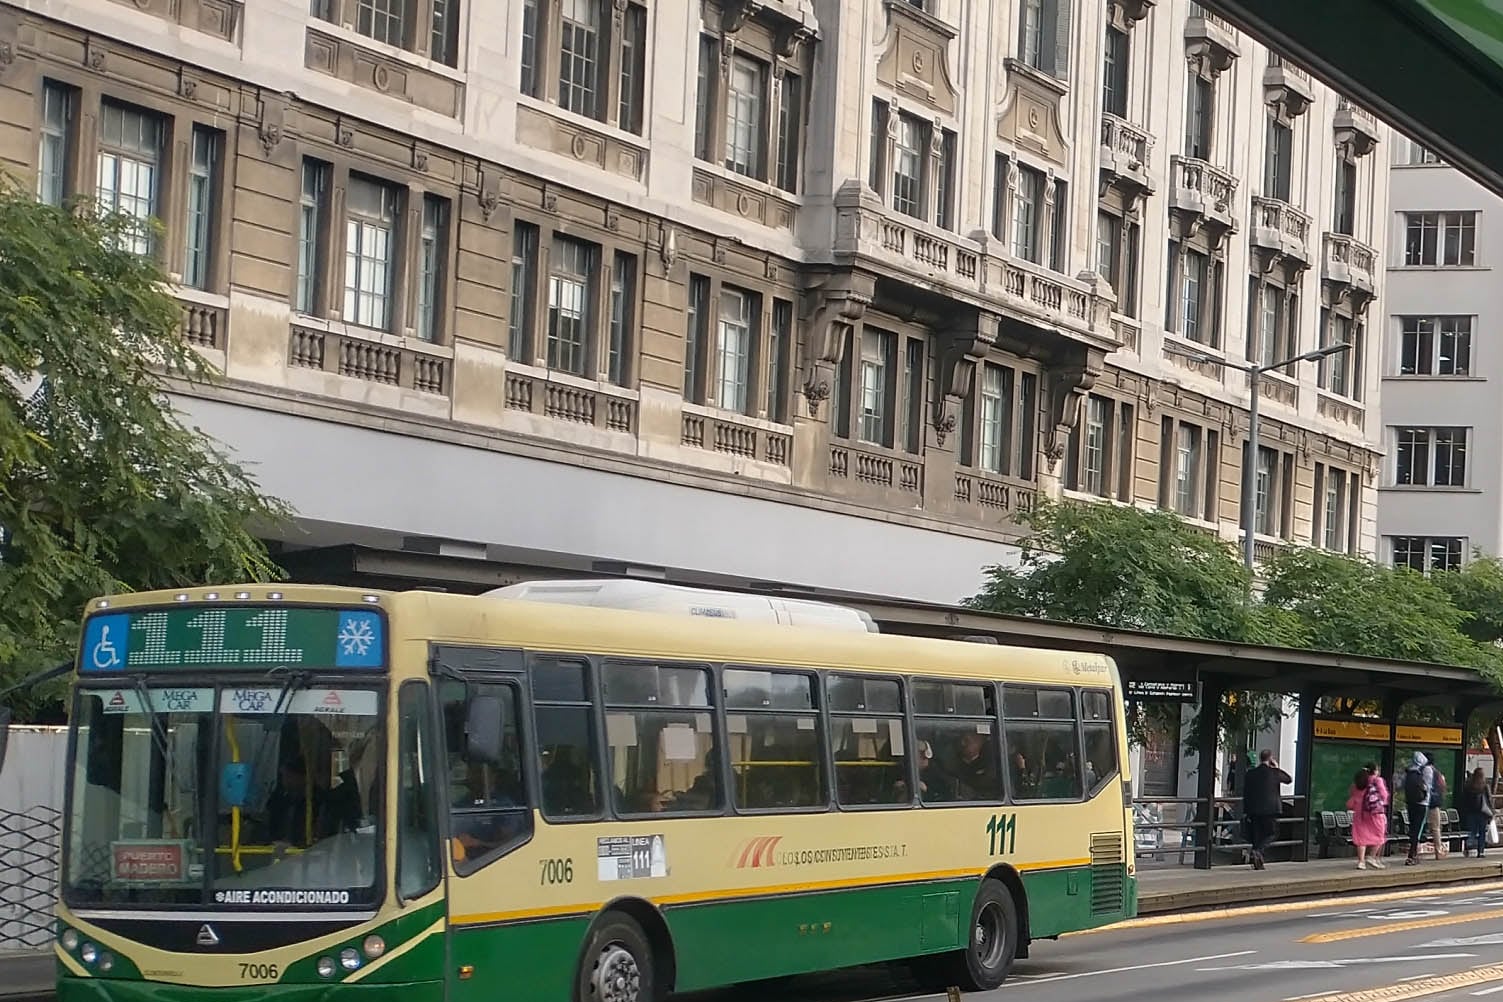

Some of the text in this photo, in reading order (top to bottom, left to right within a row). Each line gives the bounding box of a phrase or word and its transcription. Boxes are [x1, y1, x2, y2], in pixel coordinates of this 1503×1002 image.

[128, 609, 304, 664] 111
[162, 690, 198, 701] MEGA
[232, 690, 272, 701] MEGA
[168, 700, 191, 711] CAR
[239, 701, 264, 712] CAR
[985, 813, 1017, 857] 111
[633, 850, 651, 870] 111
[119, 862, 178, 875] MADERO
[539, 857, 573, 886] 7006
[224, 890, 350, 905] AIRE ACONDICIONADO
[238, 962, 279, 980] 7006
